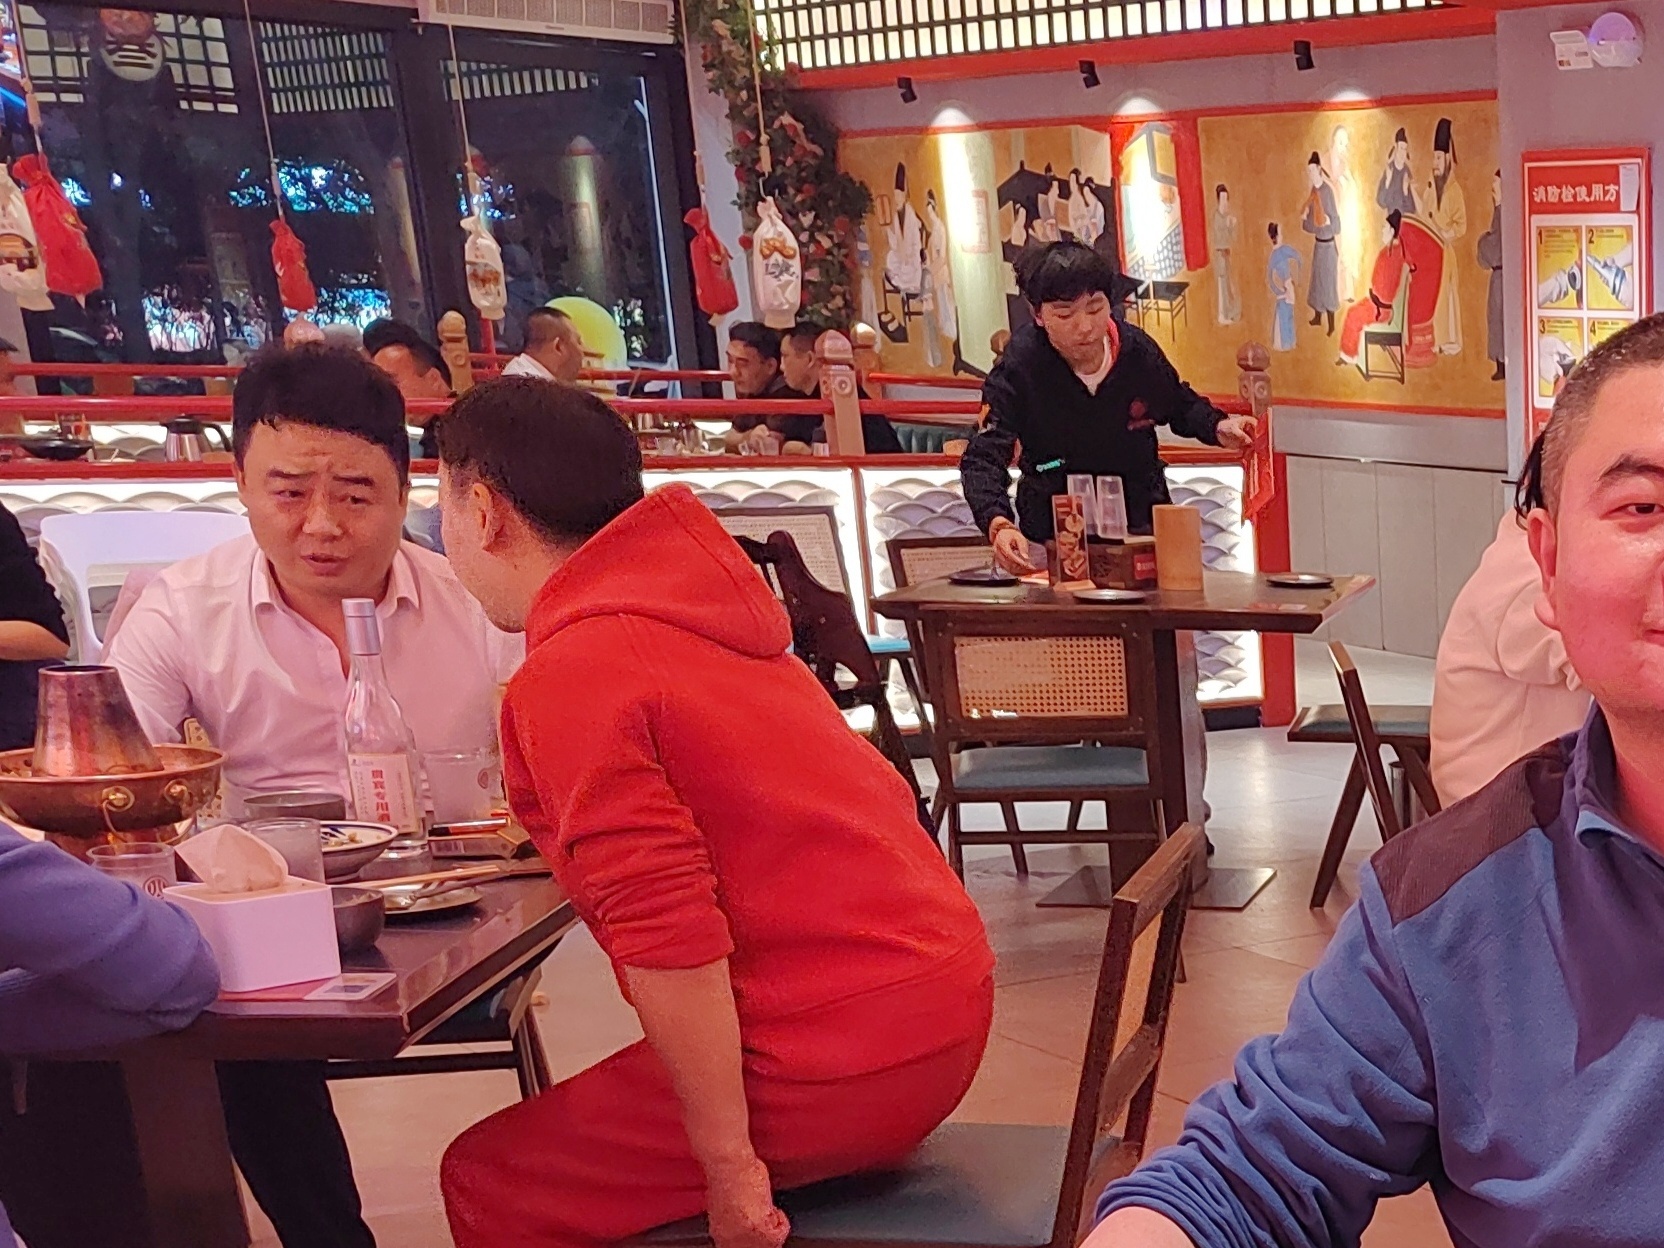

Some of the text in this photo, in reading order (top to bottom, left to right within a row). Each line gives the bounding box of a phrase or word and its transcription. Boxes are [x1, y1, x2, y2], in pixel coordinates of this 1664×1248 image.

[1588, 228, 1594, 244] 2
[1540, 319, 1546, 334] 3
[1590, 320, 1596, 335] 4
